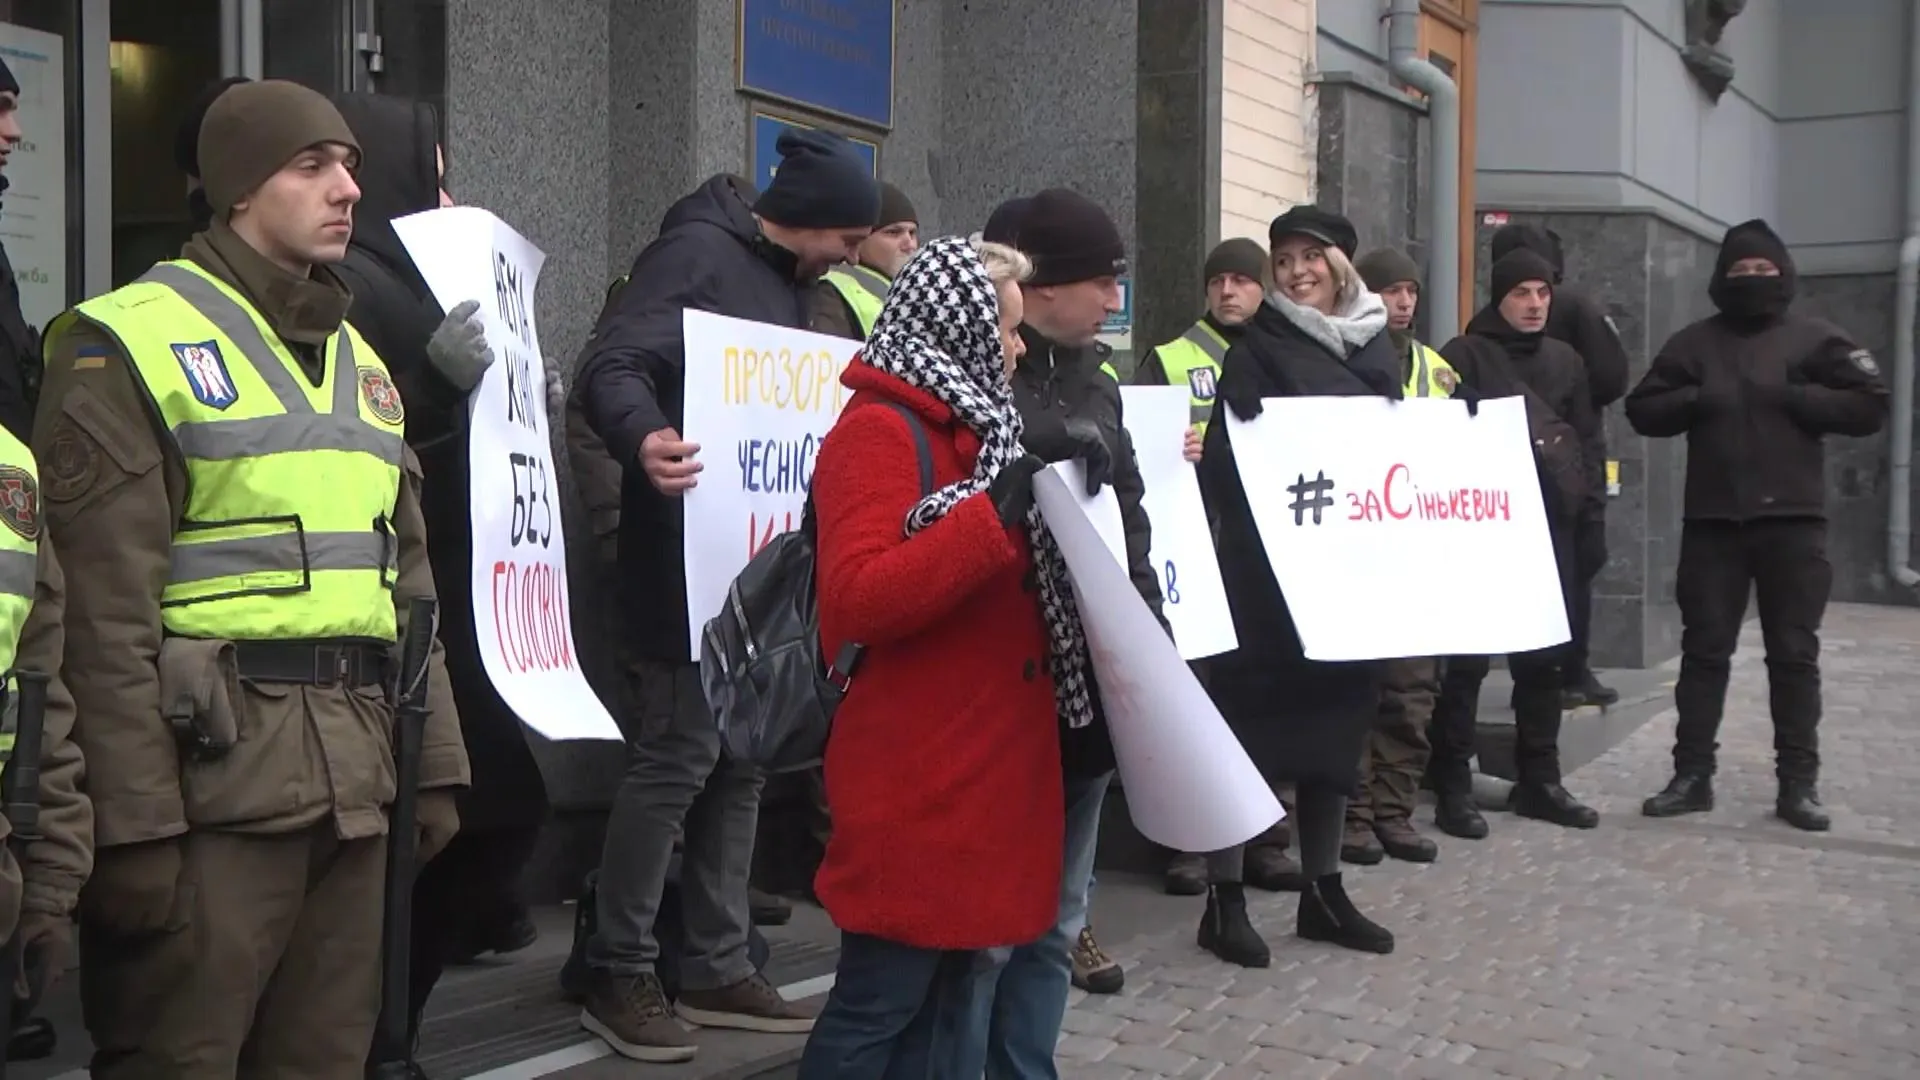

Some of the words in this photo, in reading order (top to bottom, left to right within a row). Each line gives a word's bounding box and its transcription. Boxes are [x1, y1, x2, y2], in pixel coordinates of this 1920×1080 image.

[509, 452, 551, 549] БЕЗ
[738, 433, 825, 494] ЧЕСНІС
[493, 561, 574, 674] ГОЛОВИ
